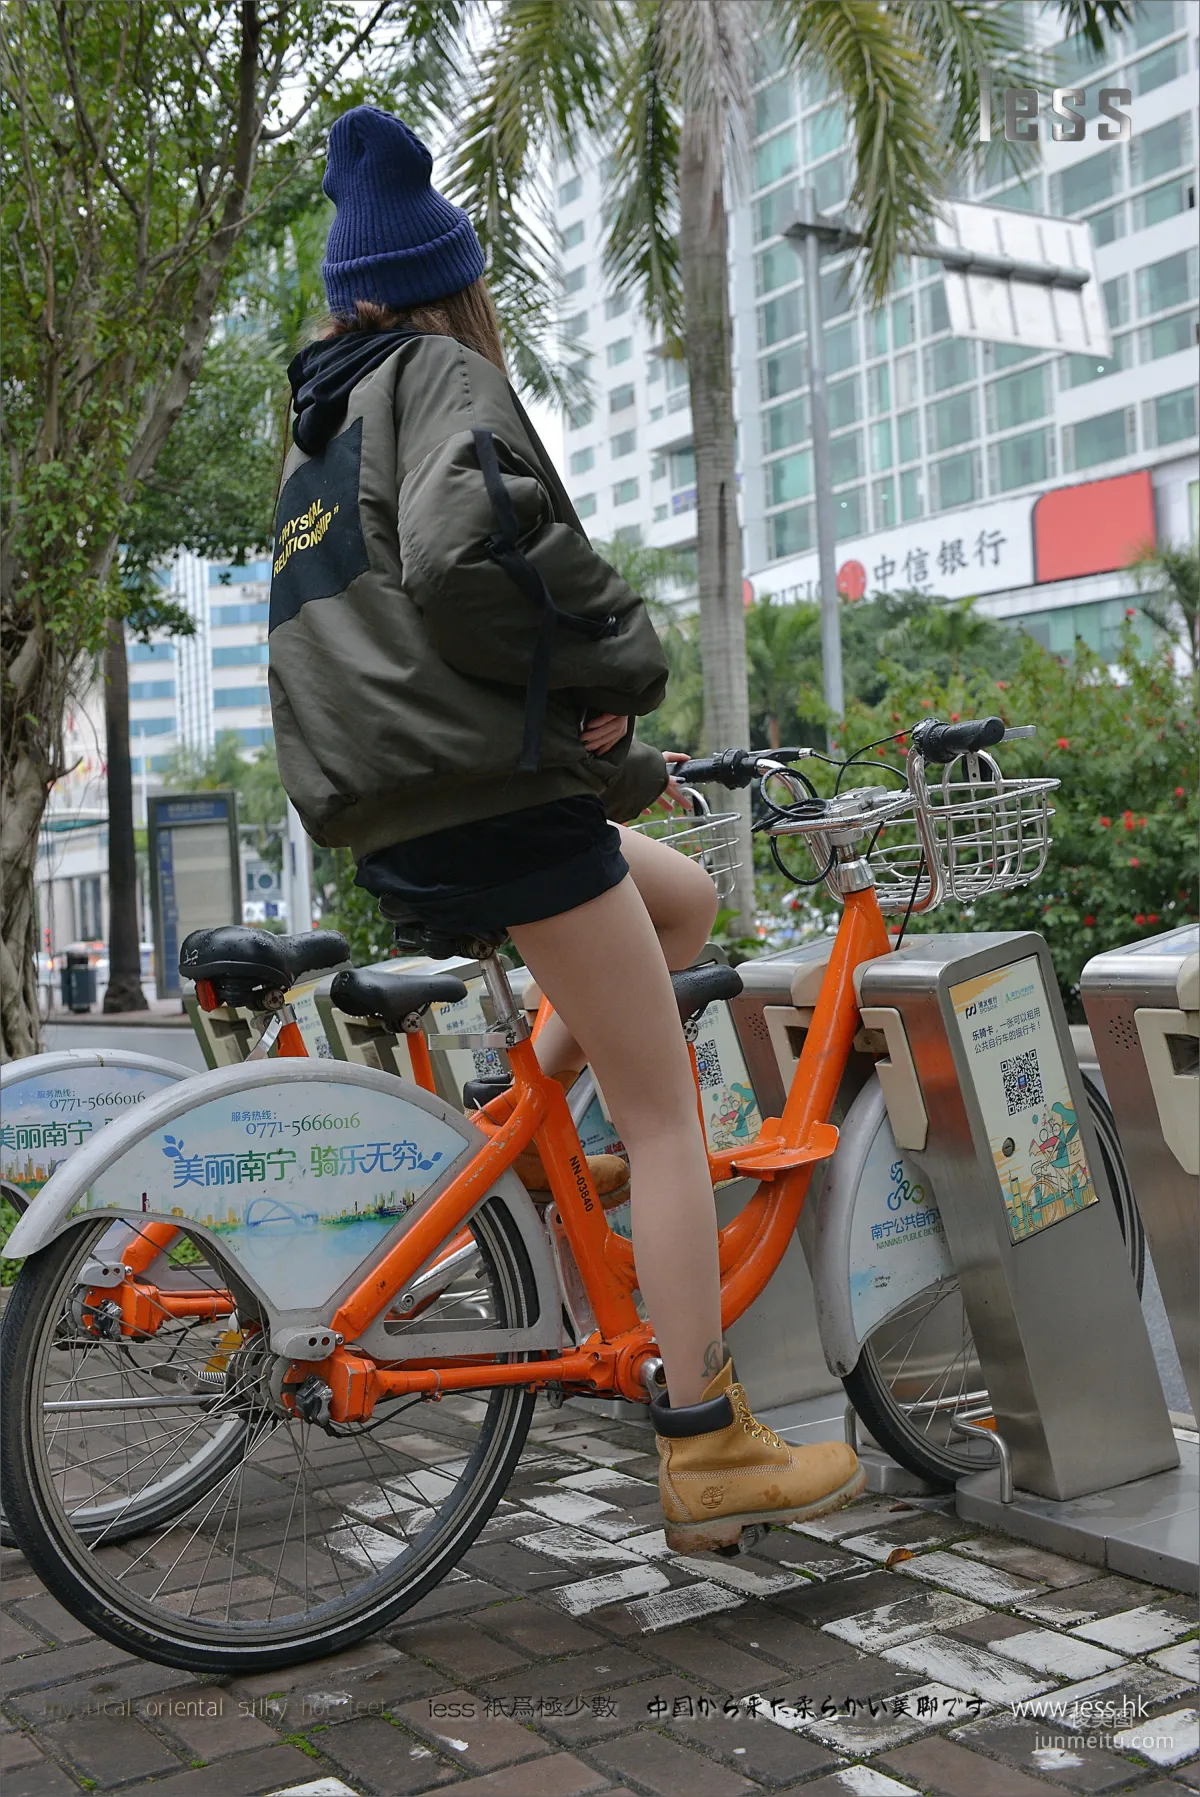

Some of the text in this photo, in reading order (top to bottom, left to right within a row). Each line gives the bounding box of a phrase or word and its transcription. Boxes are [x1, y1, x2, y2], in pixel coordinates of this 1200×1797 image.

[873, 528, 1007, 589] 中信银行
[49, 1090, 147, 1112] 0771-5666016
[246, 1112, 361, 1139] 0771-5666016
[173, 1140, 418, 1189] 美丽南宁 骑乐无穷
[569, 1155, 595, 1213] NN-03840
[902, 1229, 923, 1243] PUBLIC
